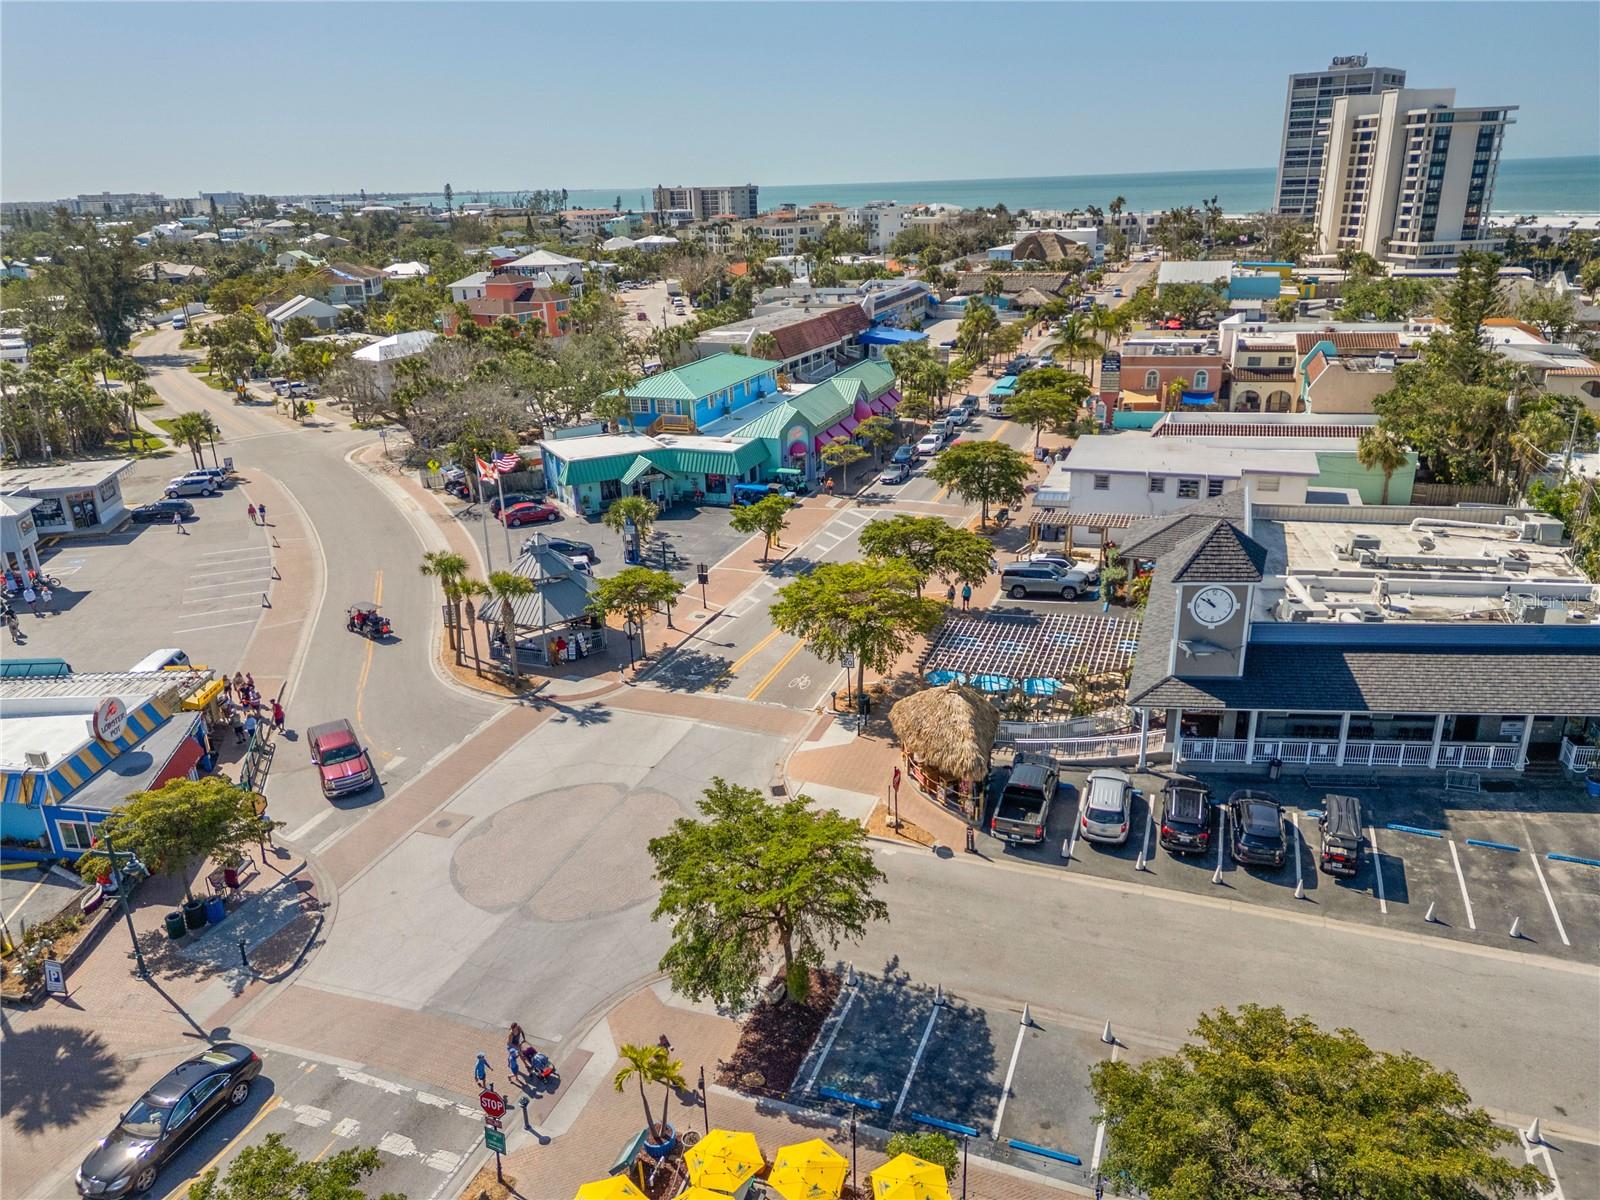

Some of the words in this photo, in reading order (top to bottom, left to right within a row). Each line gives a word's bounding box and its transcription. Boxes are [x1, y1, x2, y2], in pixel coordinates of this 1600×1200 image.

[101, 712, 126, 734] LOBSTER
[110, 725, 121, 737] POT
[481, 1097, 503, 1111] STOP
